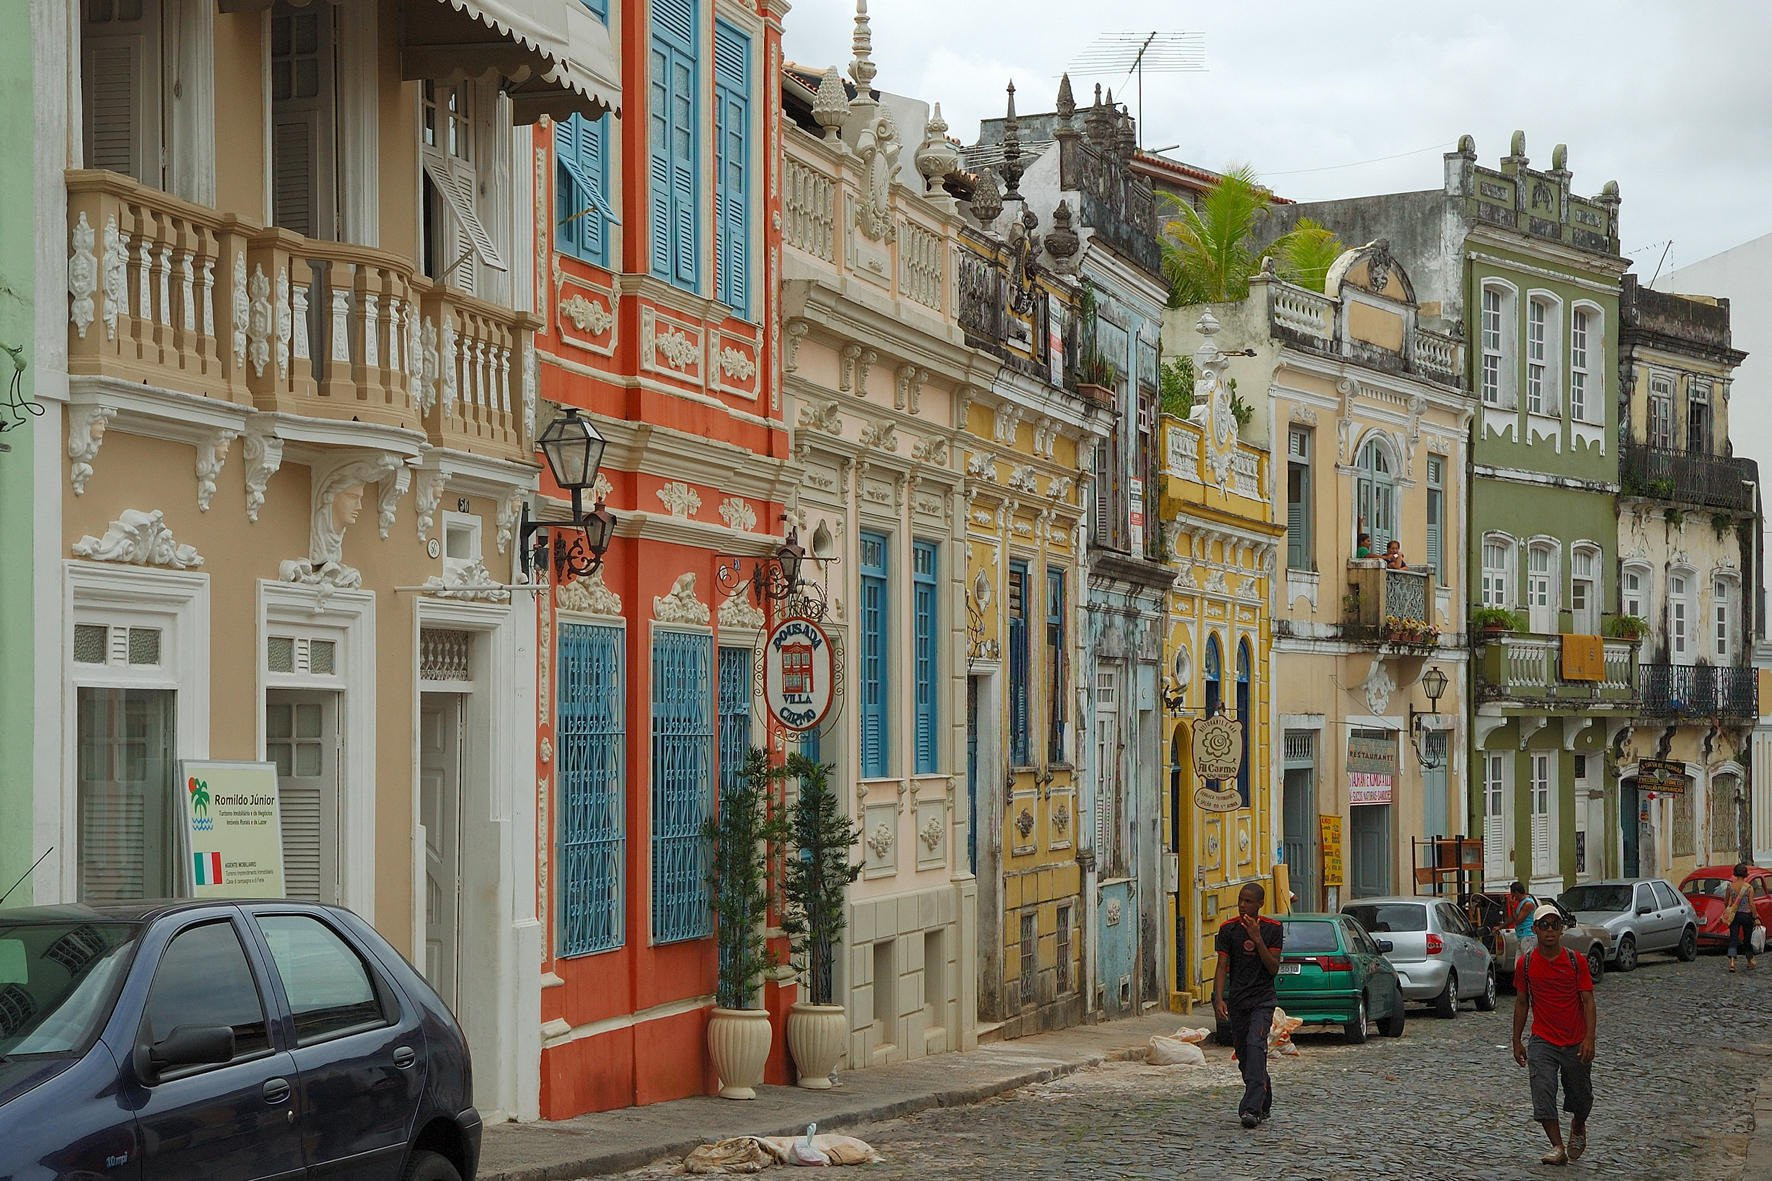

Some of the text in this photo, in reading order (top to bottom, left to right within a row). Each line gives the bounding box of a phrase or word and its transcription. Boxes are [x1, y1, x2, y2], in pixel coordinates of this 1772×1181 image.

[773, 624, 822, 653] POUSADA
[782, 694, 813, 704] VILLA
[780, 706, 817, 727] CARMO
[1350, 751, 1393, 761] RESTAURANTE
[1208, 763, 1236, 773] Carmo
[214, 793, 275, 806] Romildo Júnior
